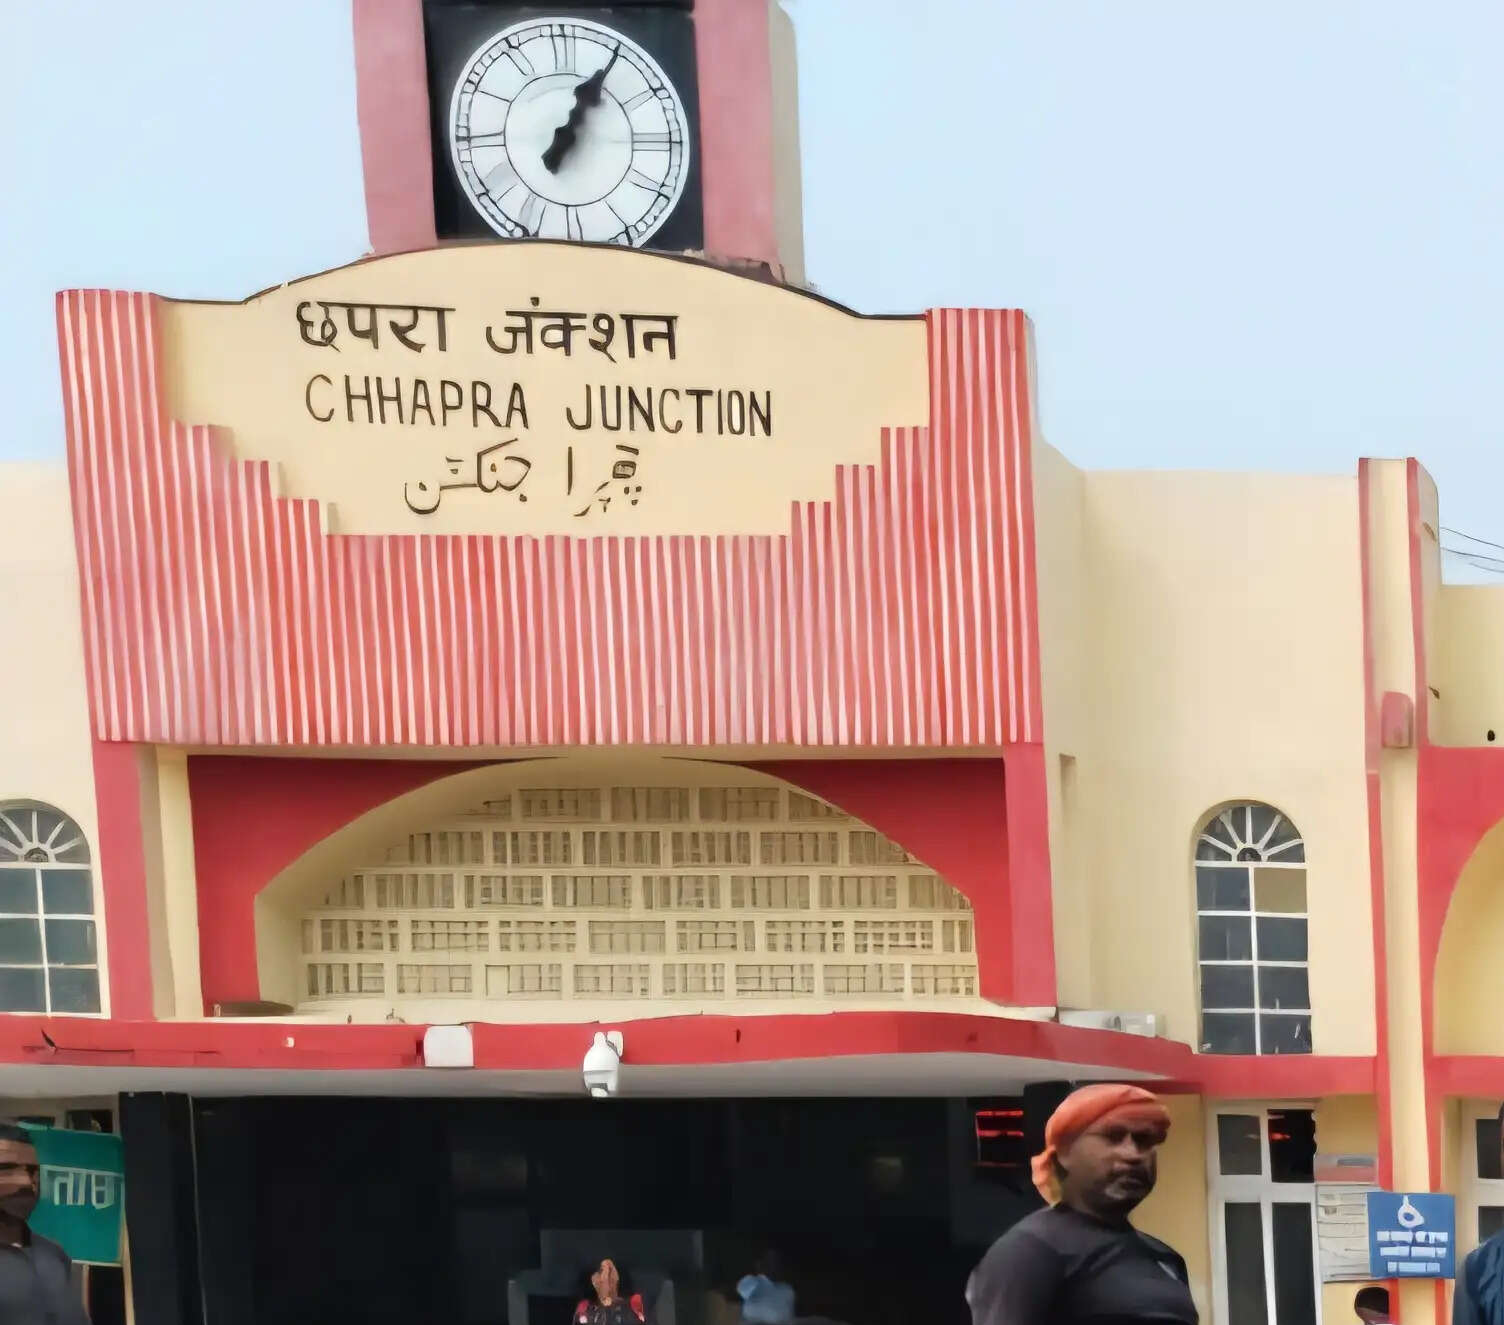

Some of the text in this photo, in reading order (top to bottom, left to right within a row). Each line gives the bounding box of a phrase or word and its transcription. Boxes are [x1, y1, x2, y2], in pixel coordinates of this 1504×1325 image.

[296, 297, 679, 363] छपरा जंक्शन
[305, 374, 772, 437] CHHAPRA JUNCTION
